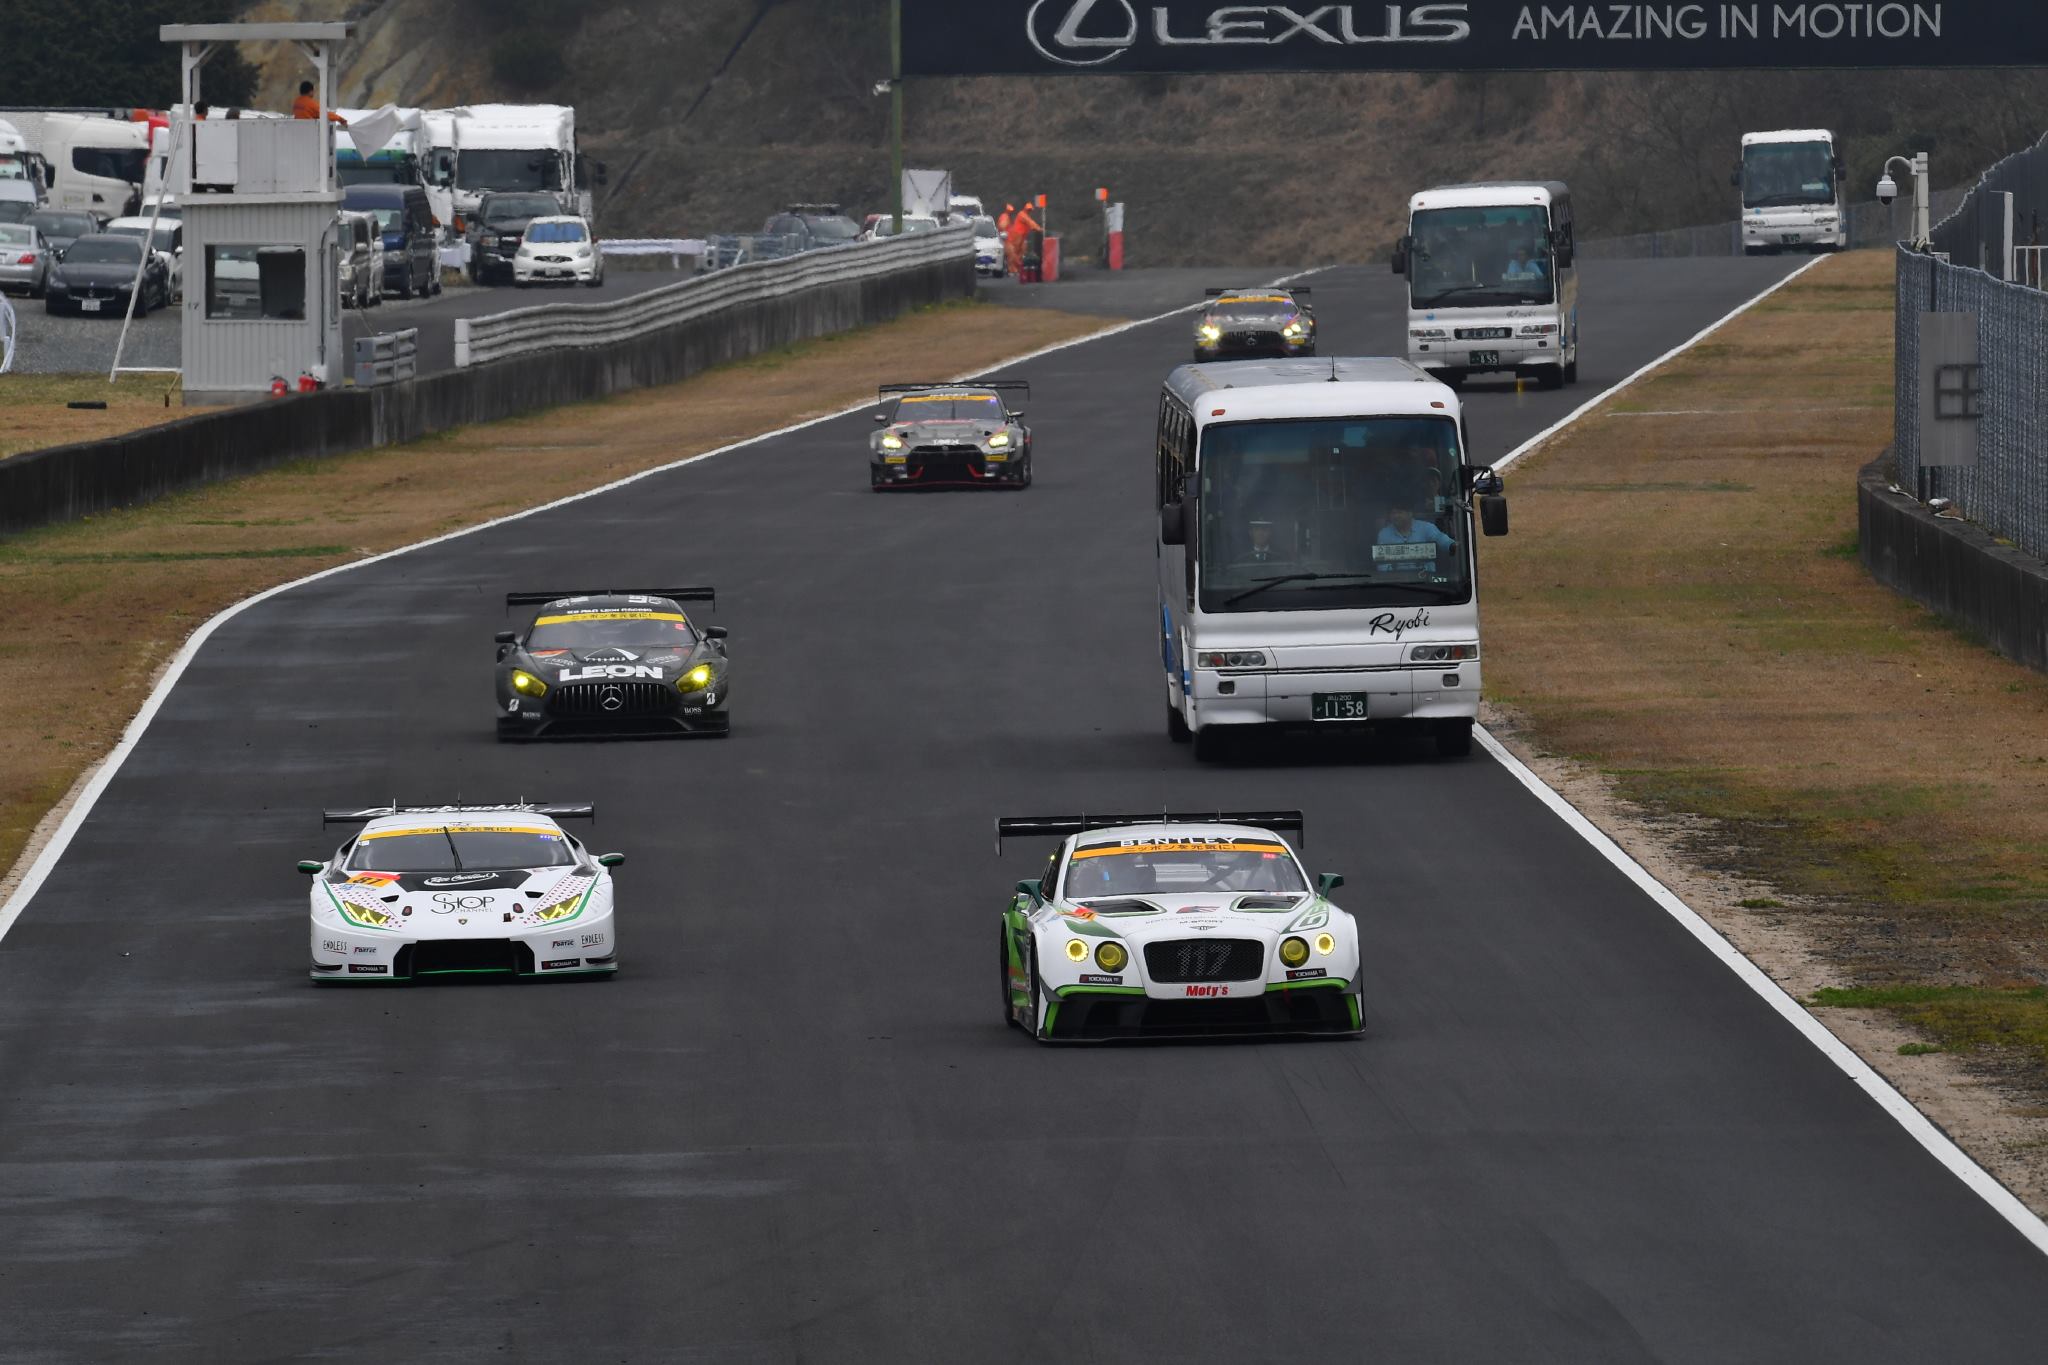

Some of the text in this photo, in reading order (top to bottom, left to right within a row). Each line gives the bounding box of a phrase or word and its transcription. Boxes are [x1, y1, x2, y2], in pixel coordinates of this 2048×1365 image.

[1151, 4, 1470, 45] LEXUS
[1511, 3, 1942, 40] AMAZING IN MOTION
[1369, 607, 1431, 641] Ryobi
[559, 664, 663, 681] LEON
[1324, 701, 1364, 717] 11-58
[1120, 837, 1236, 847] BENTLEY
[431, 892, 495, 915] SHOP
[323, 939, 347, 951] ENDLESS
[581, 934, 605, 945] ENDLESS
[1185, 985, 1229, 997] Moty's
